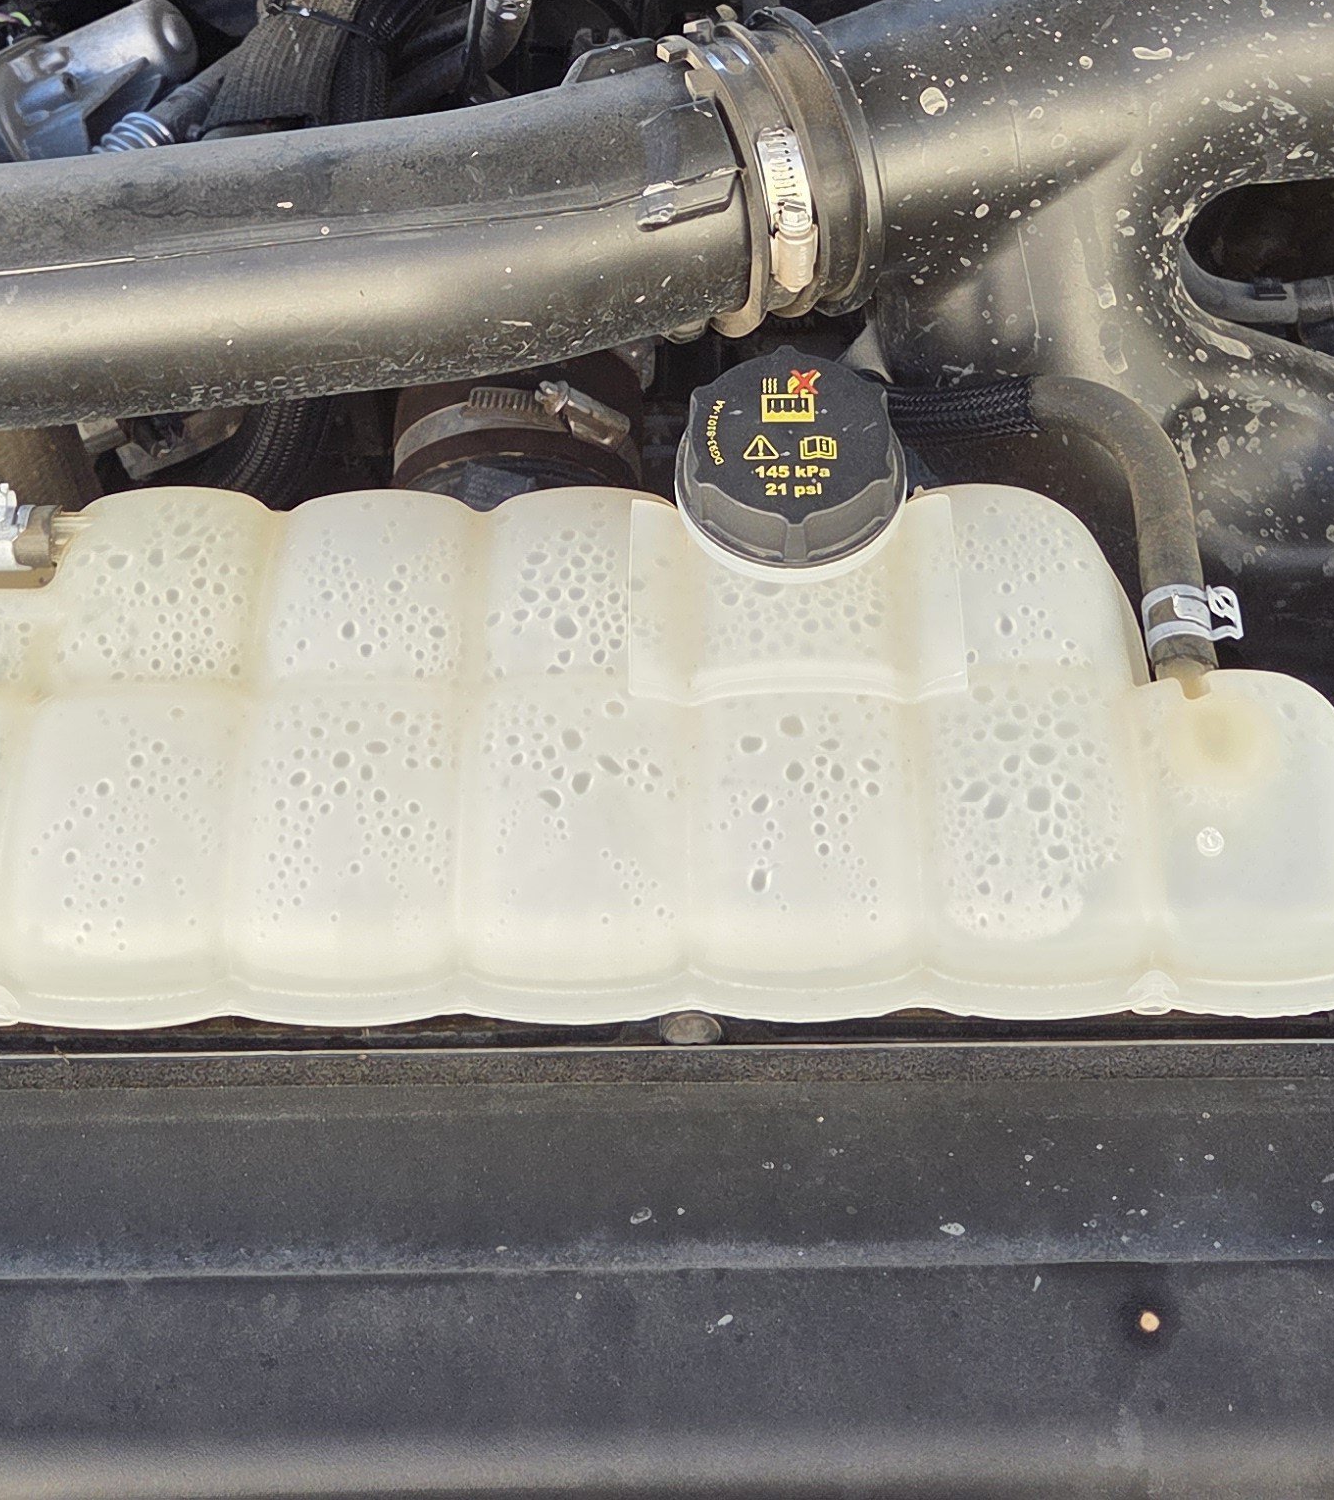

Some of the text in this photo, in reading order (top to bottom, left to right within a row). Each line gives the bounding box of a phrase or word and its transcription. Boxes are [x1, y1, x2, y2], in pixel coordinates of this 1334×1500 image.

[754, 465, 830, 478] 145 kPa
[765, 482, 823, 498] 21 psi
